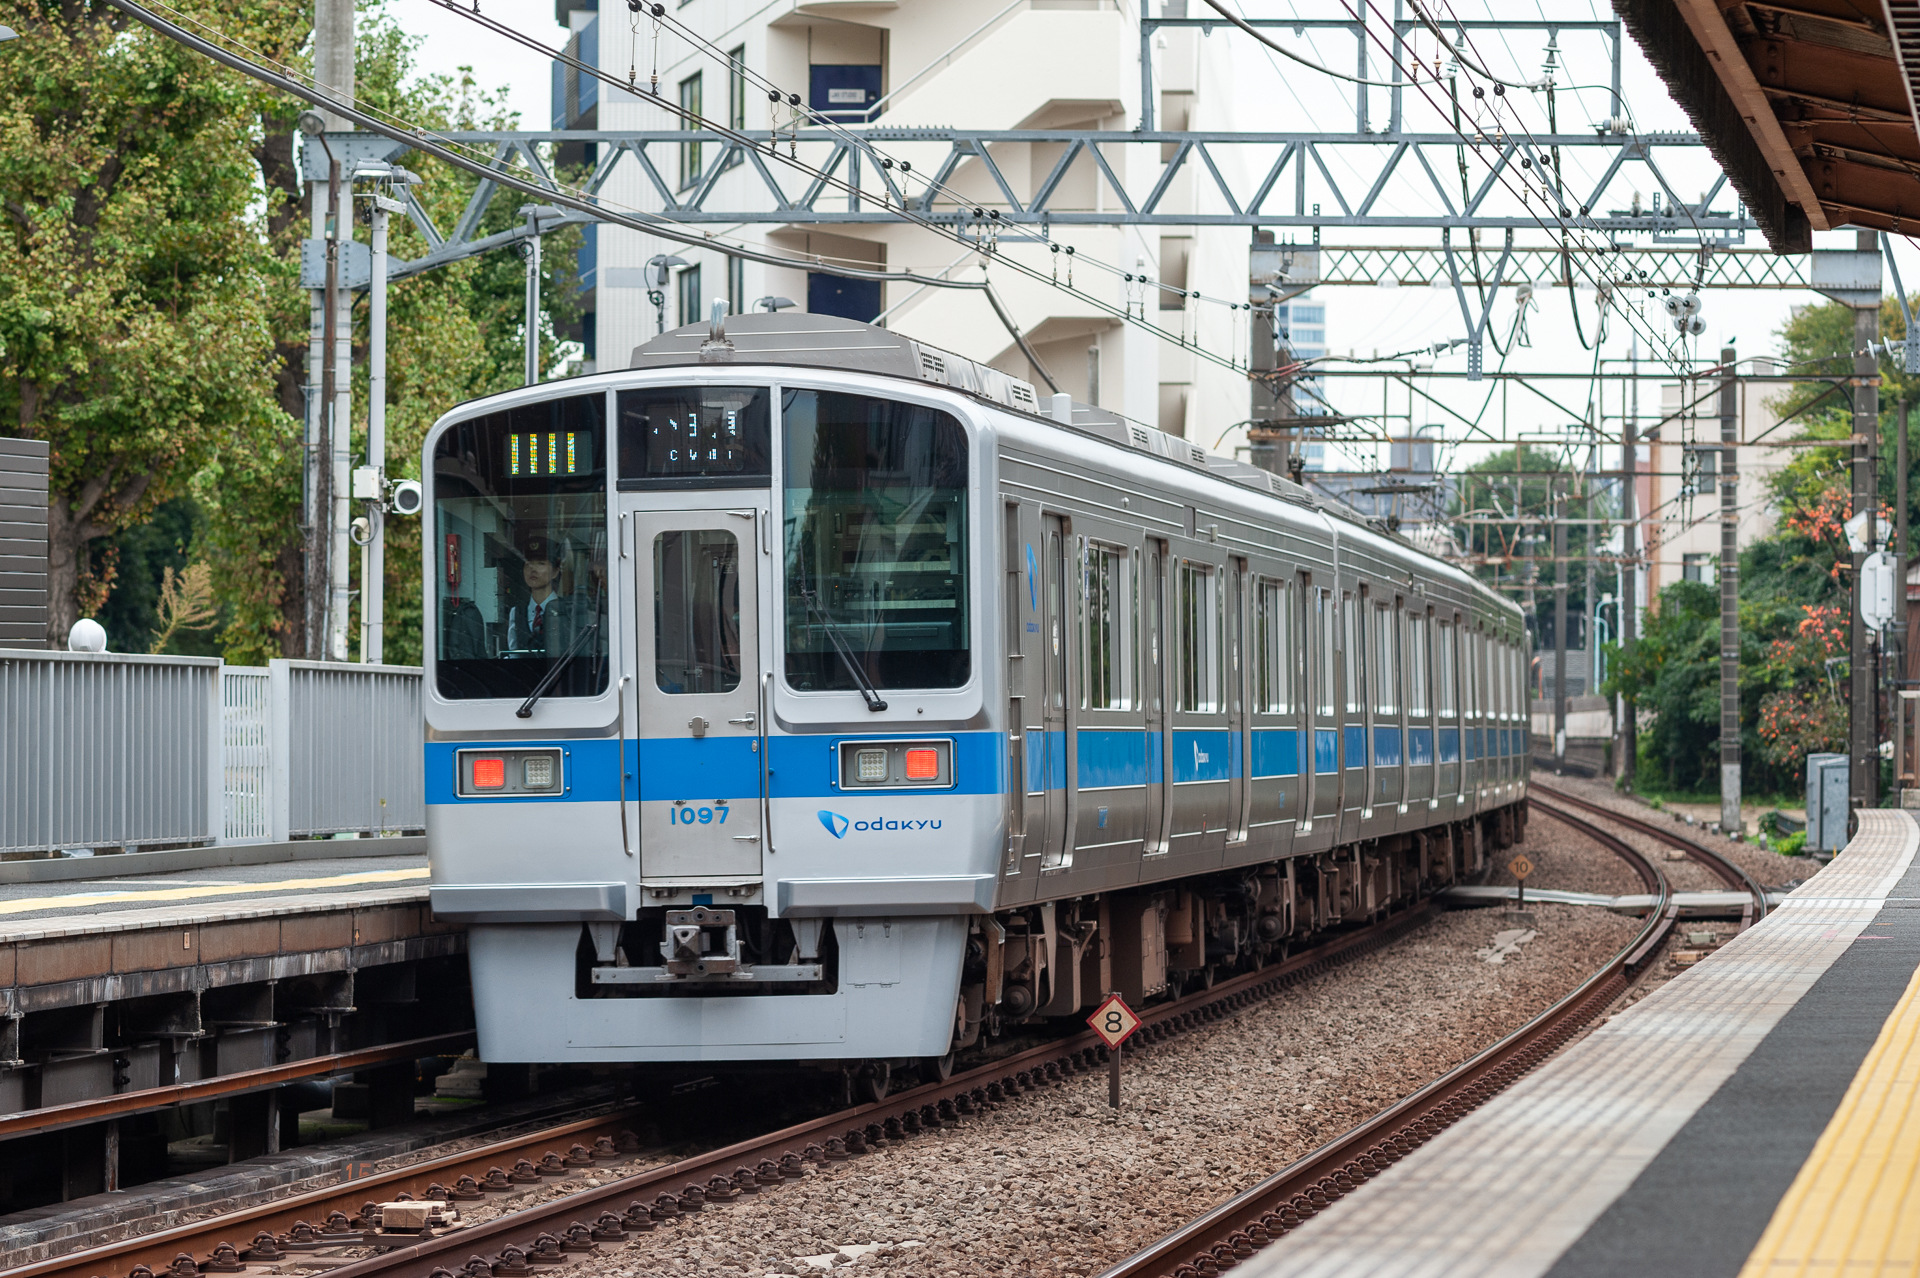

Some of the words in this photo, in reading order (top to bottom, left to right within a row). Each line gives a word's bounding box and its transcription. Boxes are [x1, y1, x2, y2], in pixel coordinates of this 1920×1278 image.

[671, 806, 730, 825] 1097
[854, 816, 942, 832] odakyu
[1514, 861, 1529, 874] 10
[1104, 1010, 1123, 1034] 8
